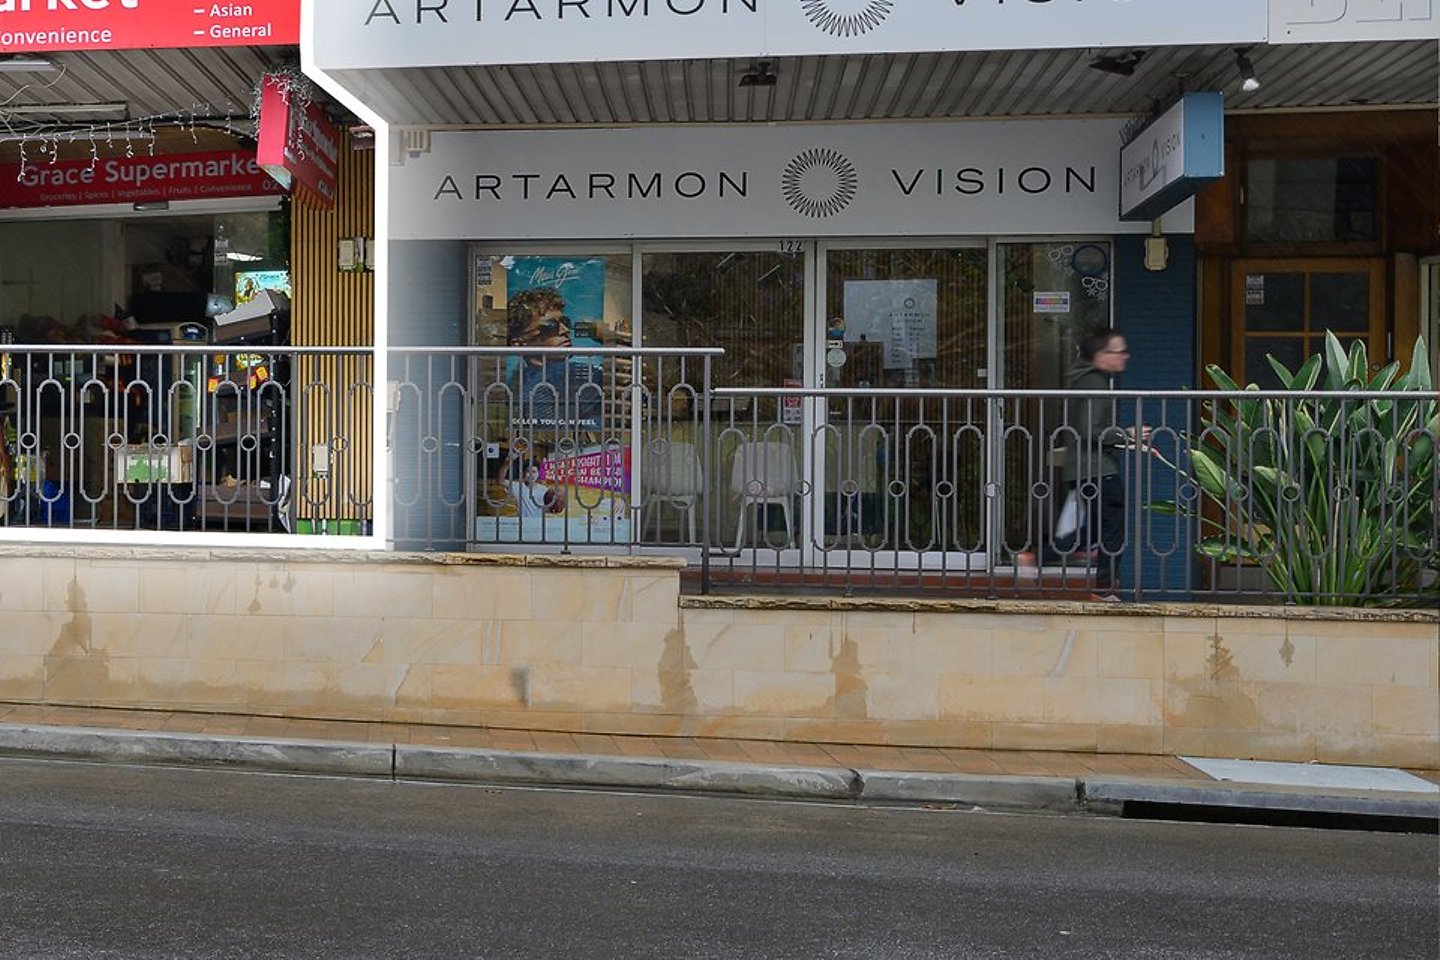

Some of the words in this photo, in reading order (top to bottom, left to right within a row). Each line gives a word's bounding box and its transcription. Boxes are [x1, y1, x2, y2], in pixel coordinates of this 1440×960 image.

[210, 3, 253, 17] Asian
[209, 22, 272, 38] General
[21, 164, 95, 187] Grace
[105, 152, 261, 187] Supermarke
[433, 171, 748, 201] ARTARMON
[891, 165, 1097, 196] VISION
[779, 240, 803, 252] 122
